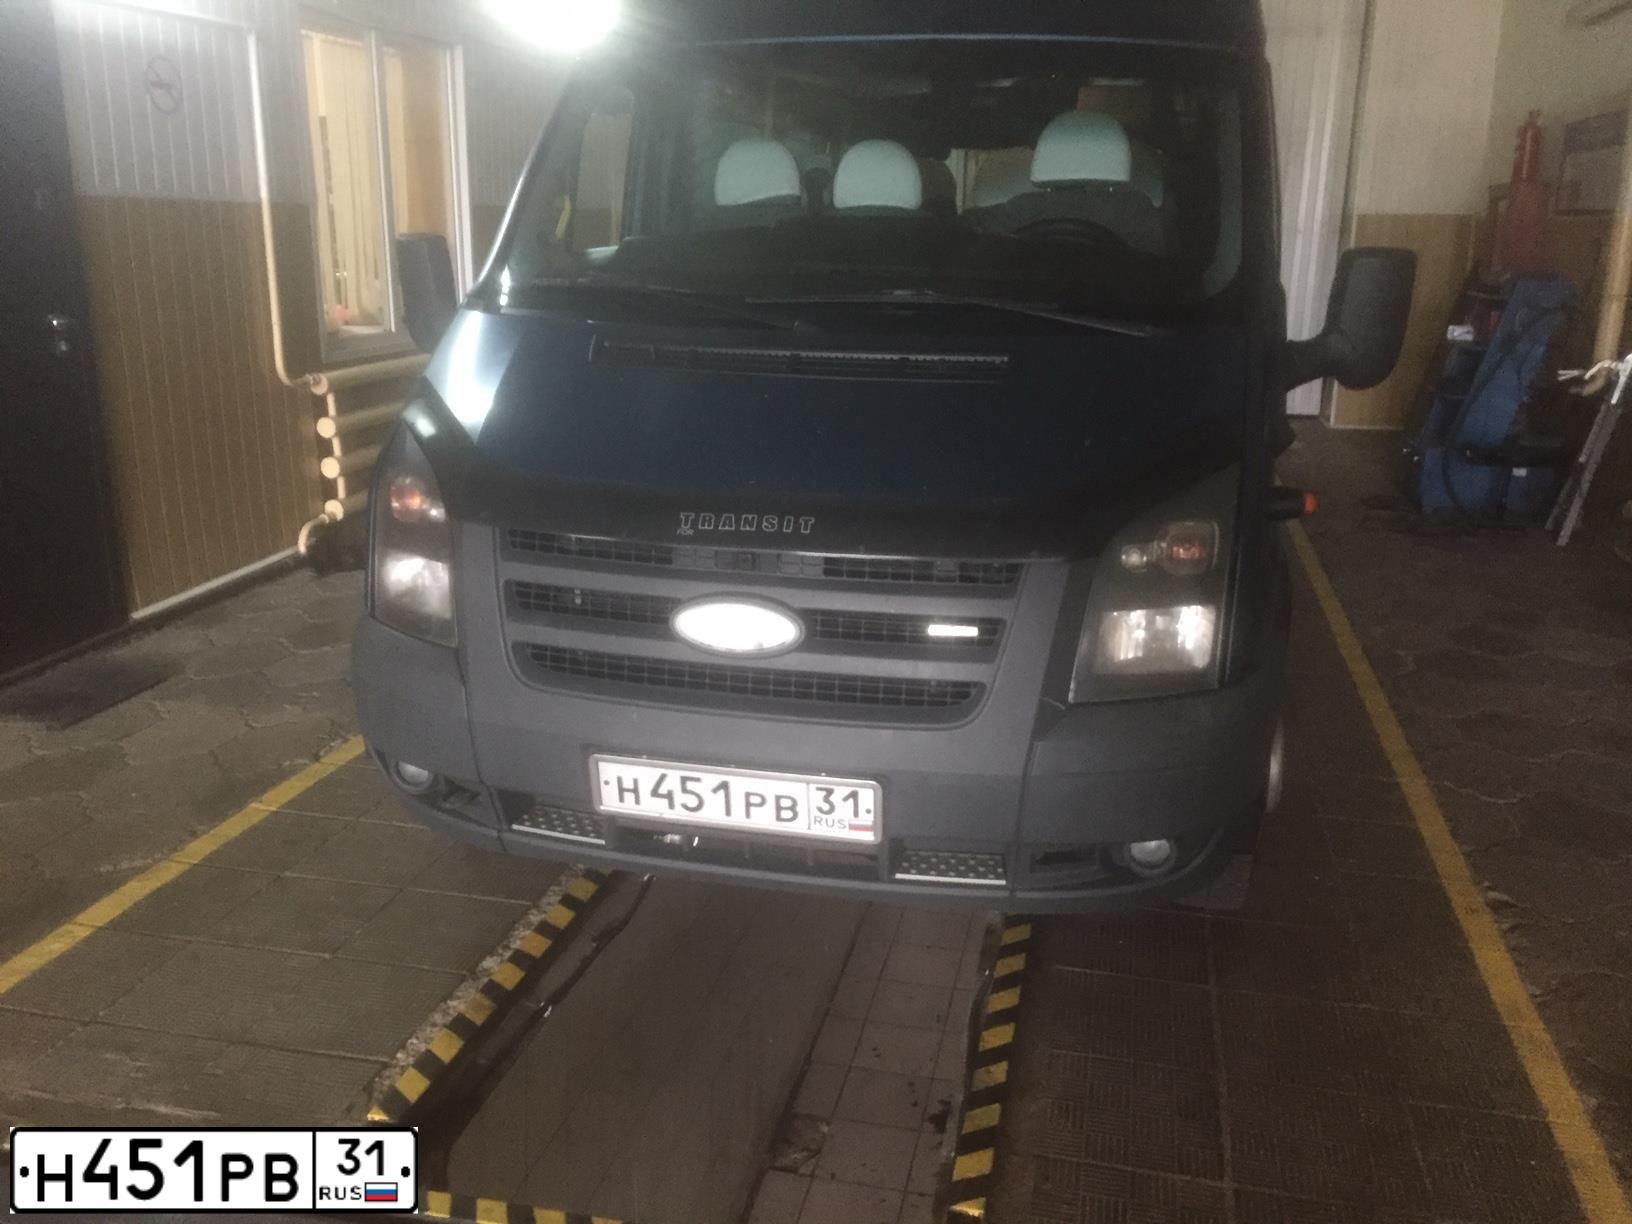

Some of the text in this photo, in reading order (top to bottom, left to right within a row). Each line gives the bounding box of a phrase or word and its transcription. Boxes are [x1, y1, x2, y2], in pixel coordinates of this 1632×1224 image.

[680, 512, 815, 533] TRANSIT
[815, 786, 860, 818] 31
[813, 816, 847, 829] RUS
